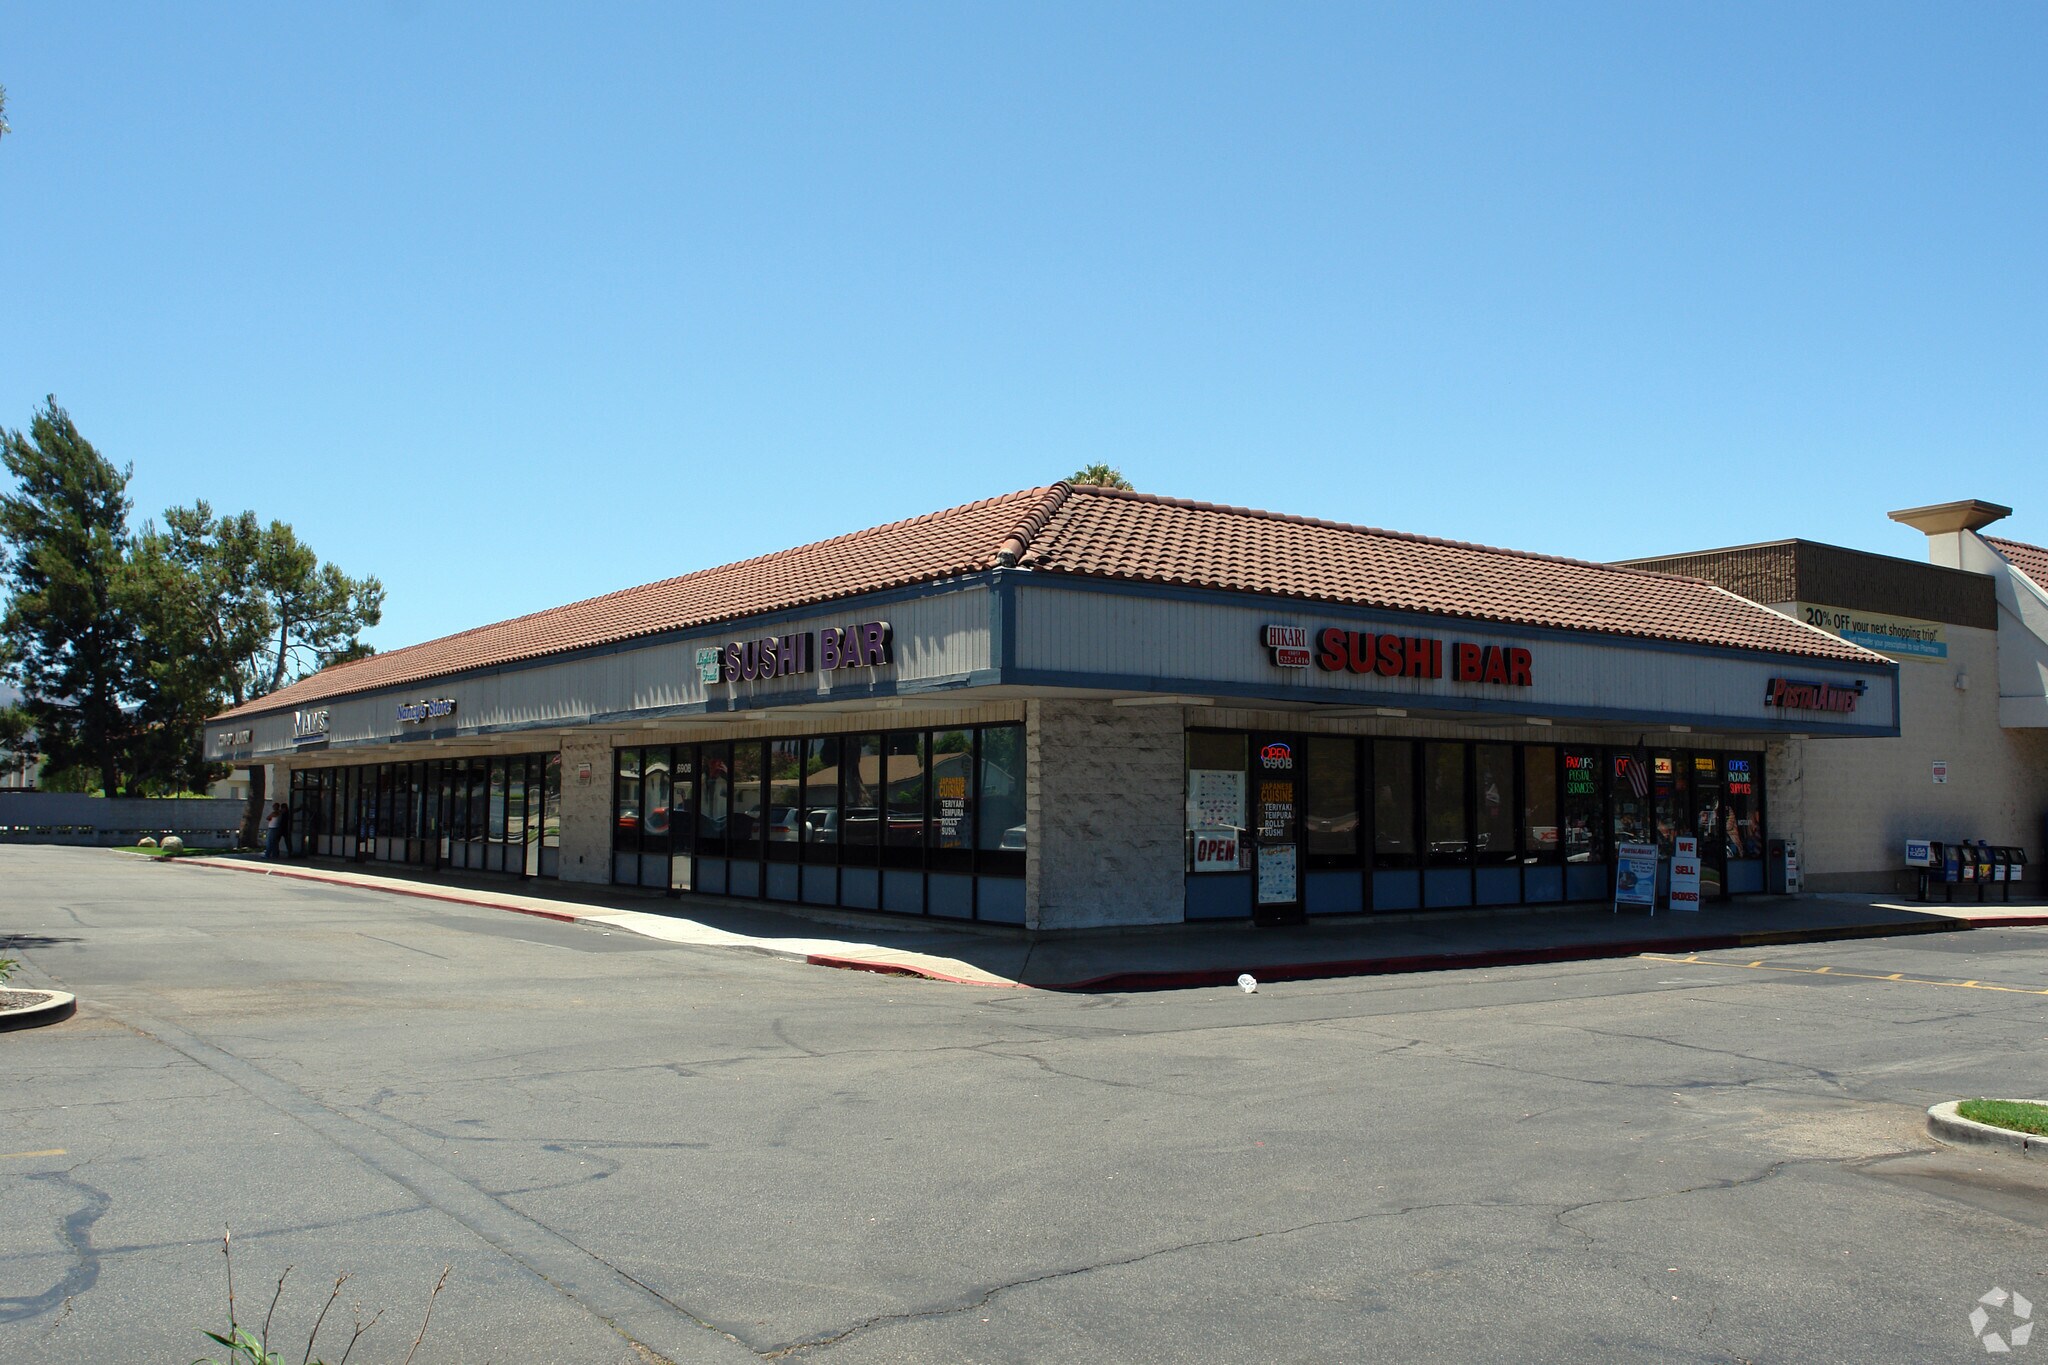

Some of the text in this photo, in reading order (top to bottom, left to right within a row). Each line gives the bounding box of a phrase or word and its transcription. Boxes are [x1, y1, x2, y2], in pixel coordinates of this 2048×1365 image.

[1805, 607, 1831, 626] 20%
[1834, 614, 1850, 630] OFF
[1852, 620, 1869, 634] your
[1871, 622, 1887, 635] next
[1889, 624, 1920, 642] shopping
[1269, 627, 1306, 647] HIKARI
[725, 621, 888, 682] SUSHI BAR
[1321, 628, 1532, 686] SUSHI BAR
[396, 699, 452, 724] Nancy's Store
[1261, 745, 1291, 760] OPEN
[1728, 760, 1750, 771] COPIES
[1568, 769, 1591, 781] POSTAL
[939, 784, 965, 797] CUISINE
[1567, 782, 1595, 794] SERVICES
[1729, 783, 1752, 794] SUPPLIES
[1261, 791, 1293, 802] CUISINE
[942, 800, 964, 808] TERIYAKI
[1265, 803, 1293, 811] TERIYAKI
[942, 808, 964, 816] TEMPURA
[1265, 820, 1284, 828] ROLLS
[1264, 828, 1284, 837] SUSHI
[1197, 840, 1236, 861] OPEN
[1678, 842, 1693, 851] WE
[1675, 865, 1695, 875] SELL
[1671, 891, 1698, 901] BOXES
